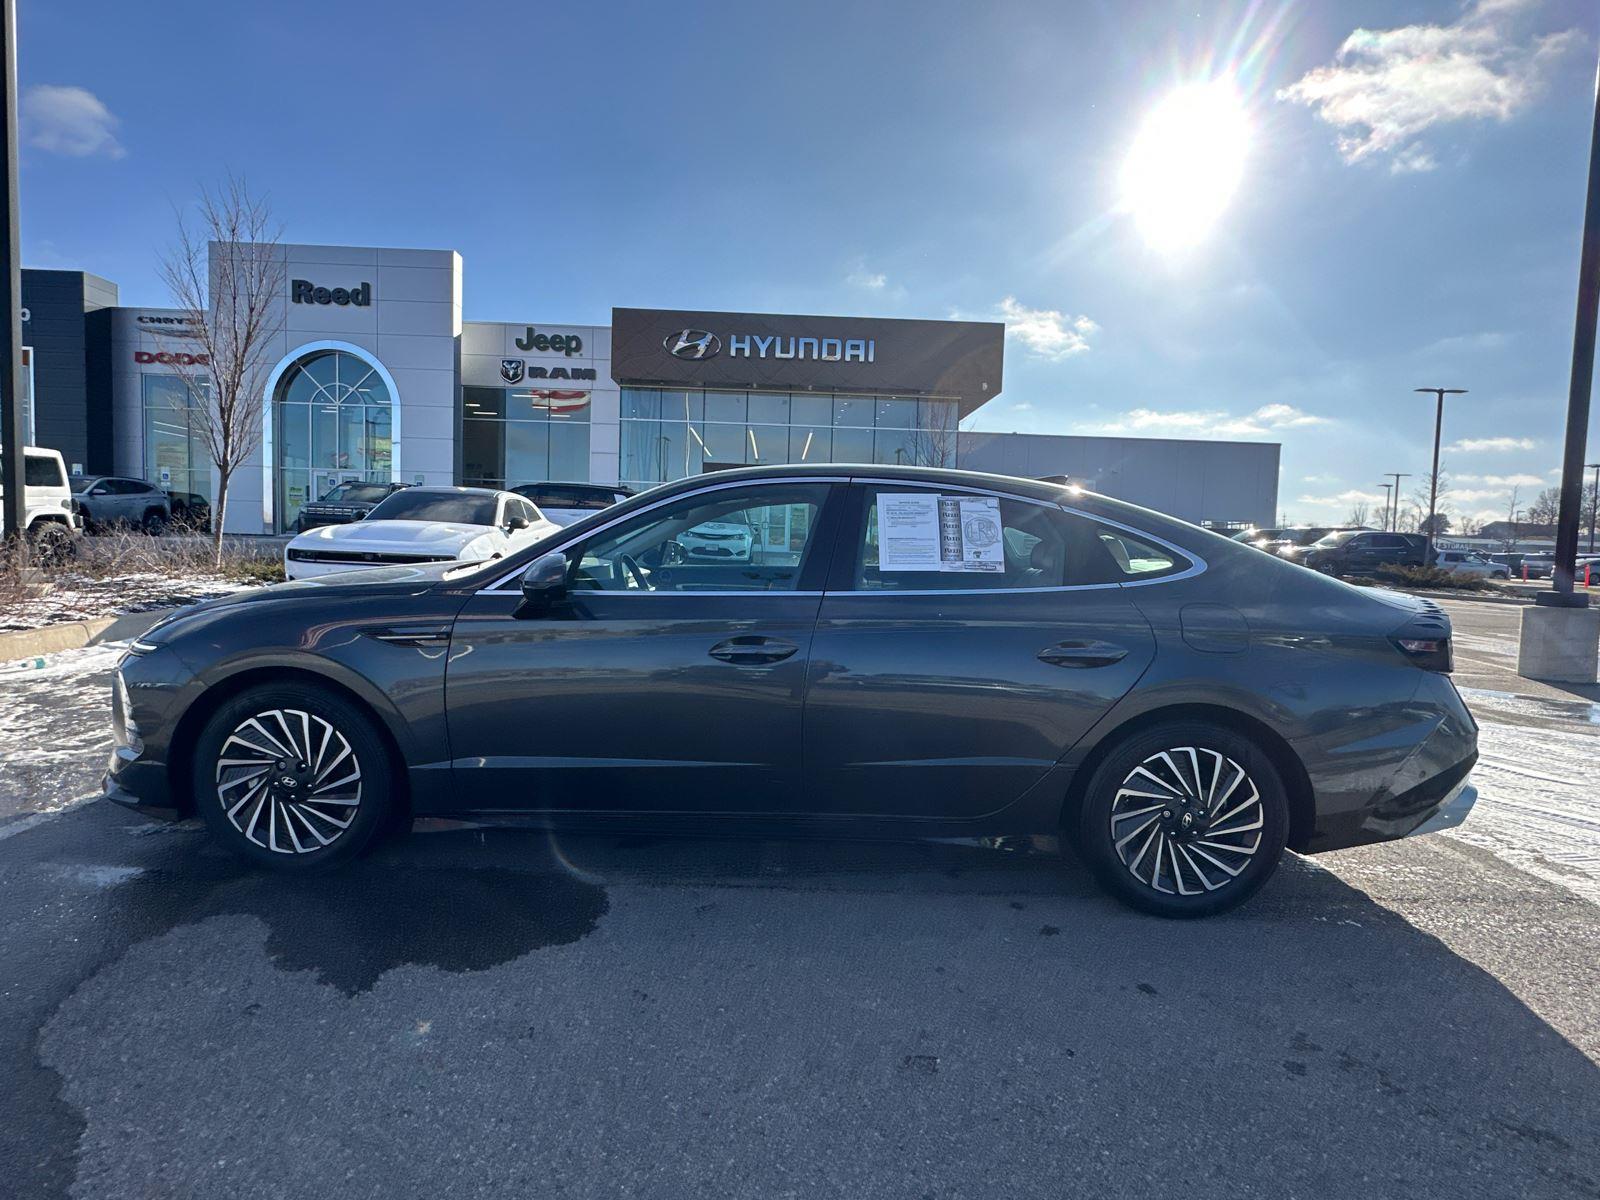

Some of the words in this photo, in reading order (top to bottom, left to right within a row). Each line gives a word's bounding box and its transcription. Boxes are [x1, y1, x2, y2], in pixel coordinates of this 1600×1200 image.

[291, 279, 371, 307] Reed
[515, 326, 583, 357] Jeep
[729, 334, 876, 363] HYUNDAI
[528, 366, 597, 381] RAM
